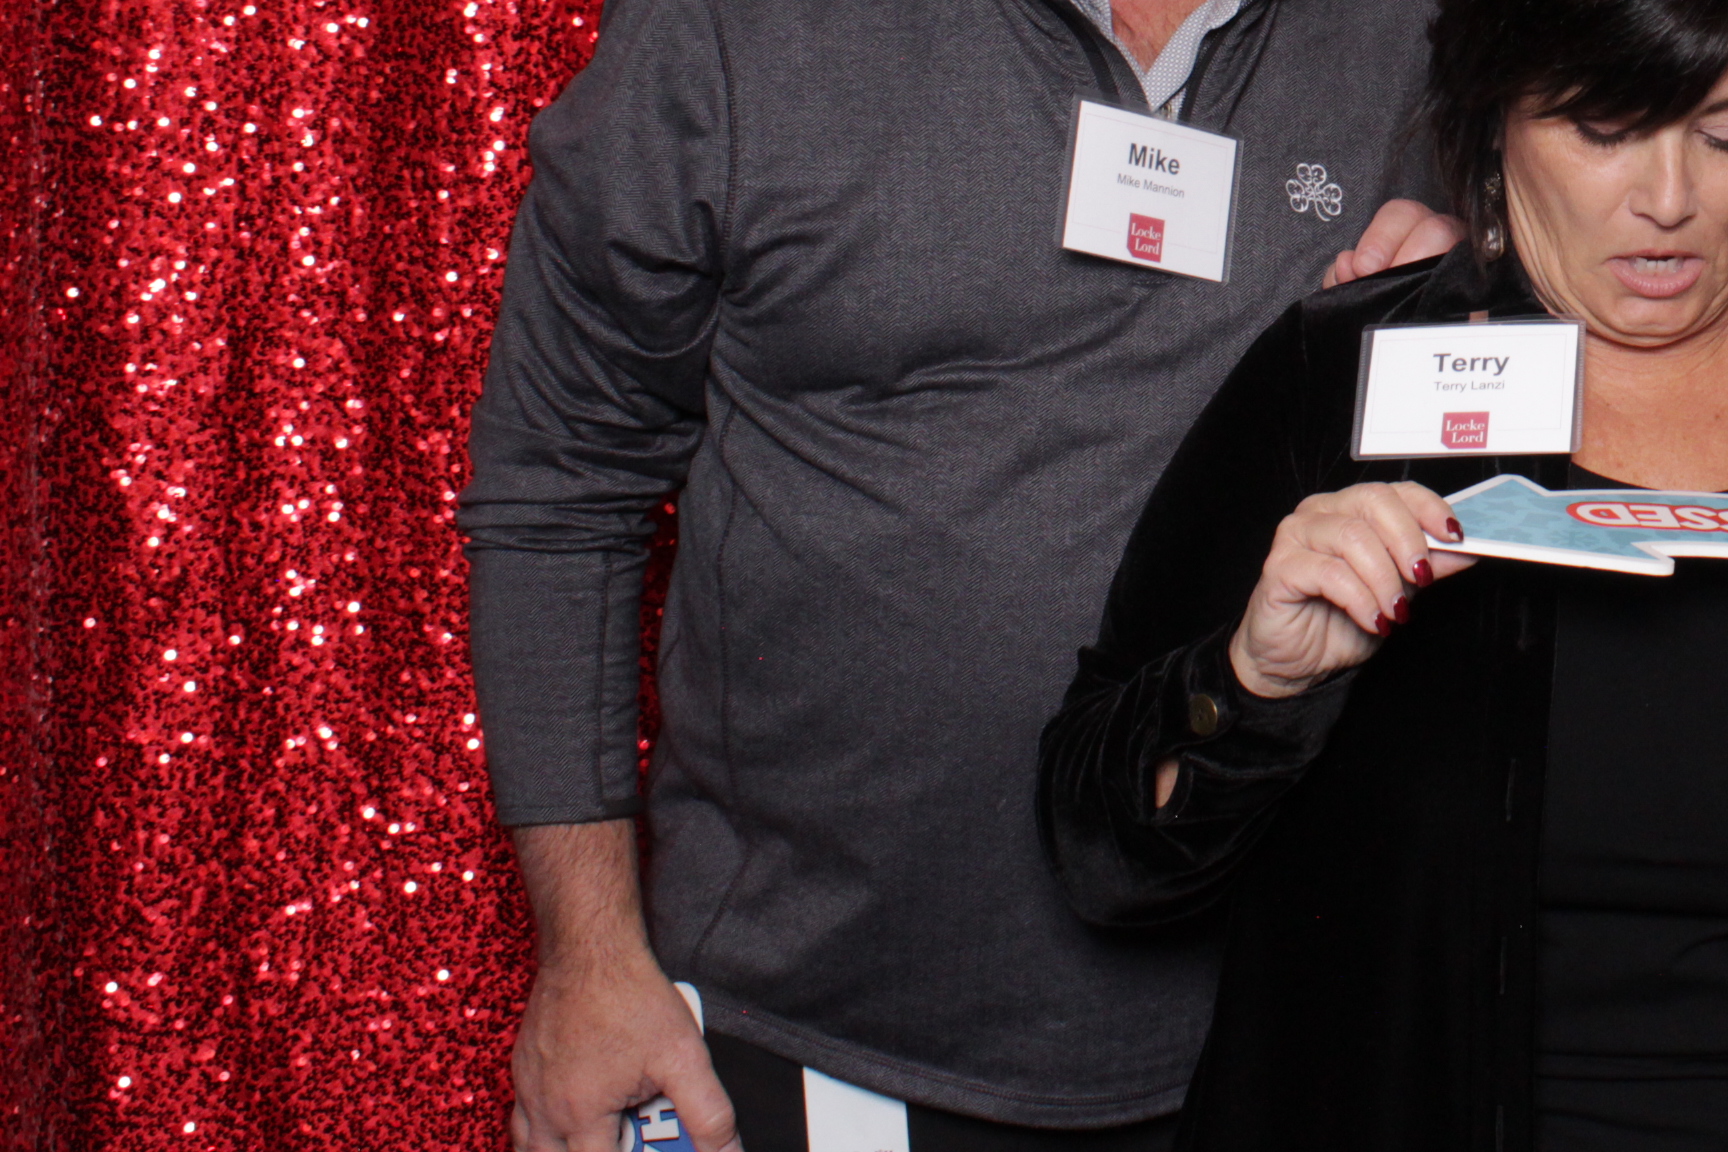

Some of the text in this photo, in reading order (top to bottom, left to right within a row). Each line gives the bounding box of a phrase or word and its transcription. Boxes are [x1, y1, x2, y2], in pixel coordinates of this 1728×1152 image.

[1128, 143, 1180, 175] Mike
[1116, 172, 1185, 199] Mike Mannion
[1130, 222, 1162, 240] Locke
[1134, 237, 1160, 256] Lord
[1433, 353, 1510, 376] Terry
[1434, 380, 1505, 393] Terry Lanzi
[1446, 419, 1485, 432] Locke
[1451, 432, 1484, 444] Lord
